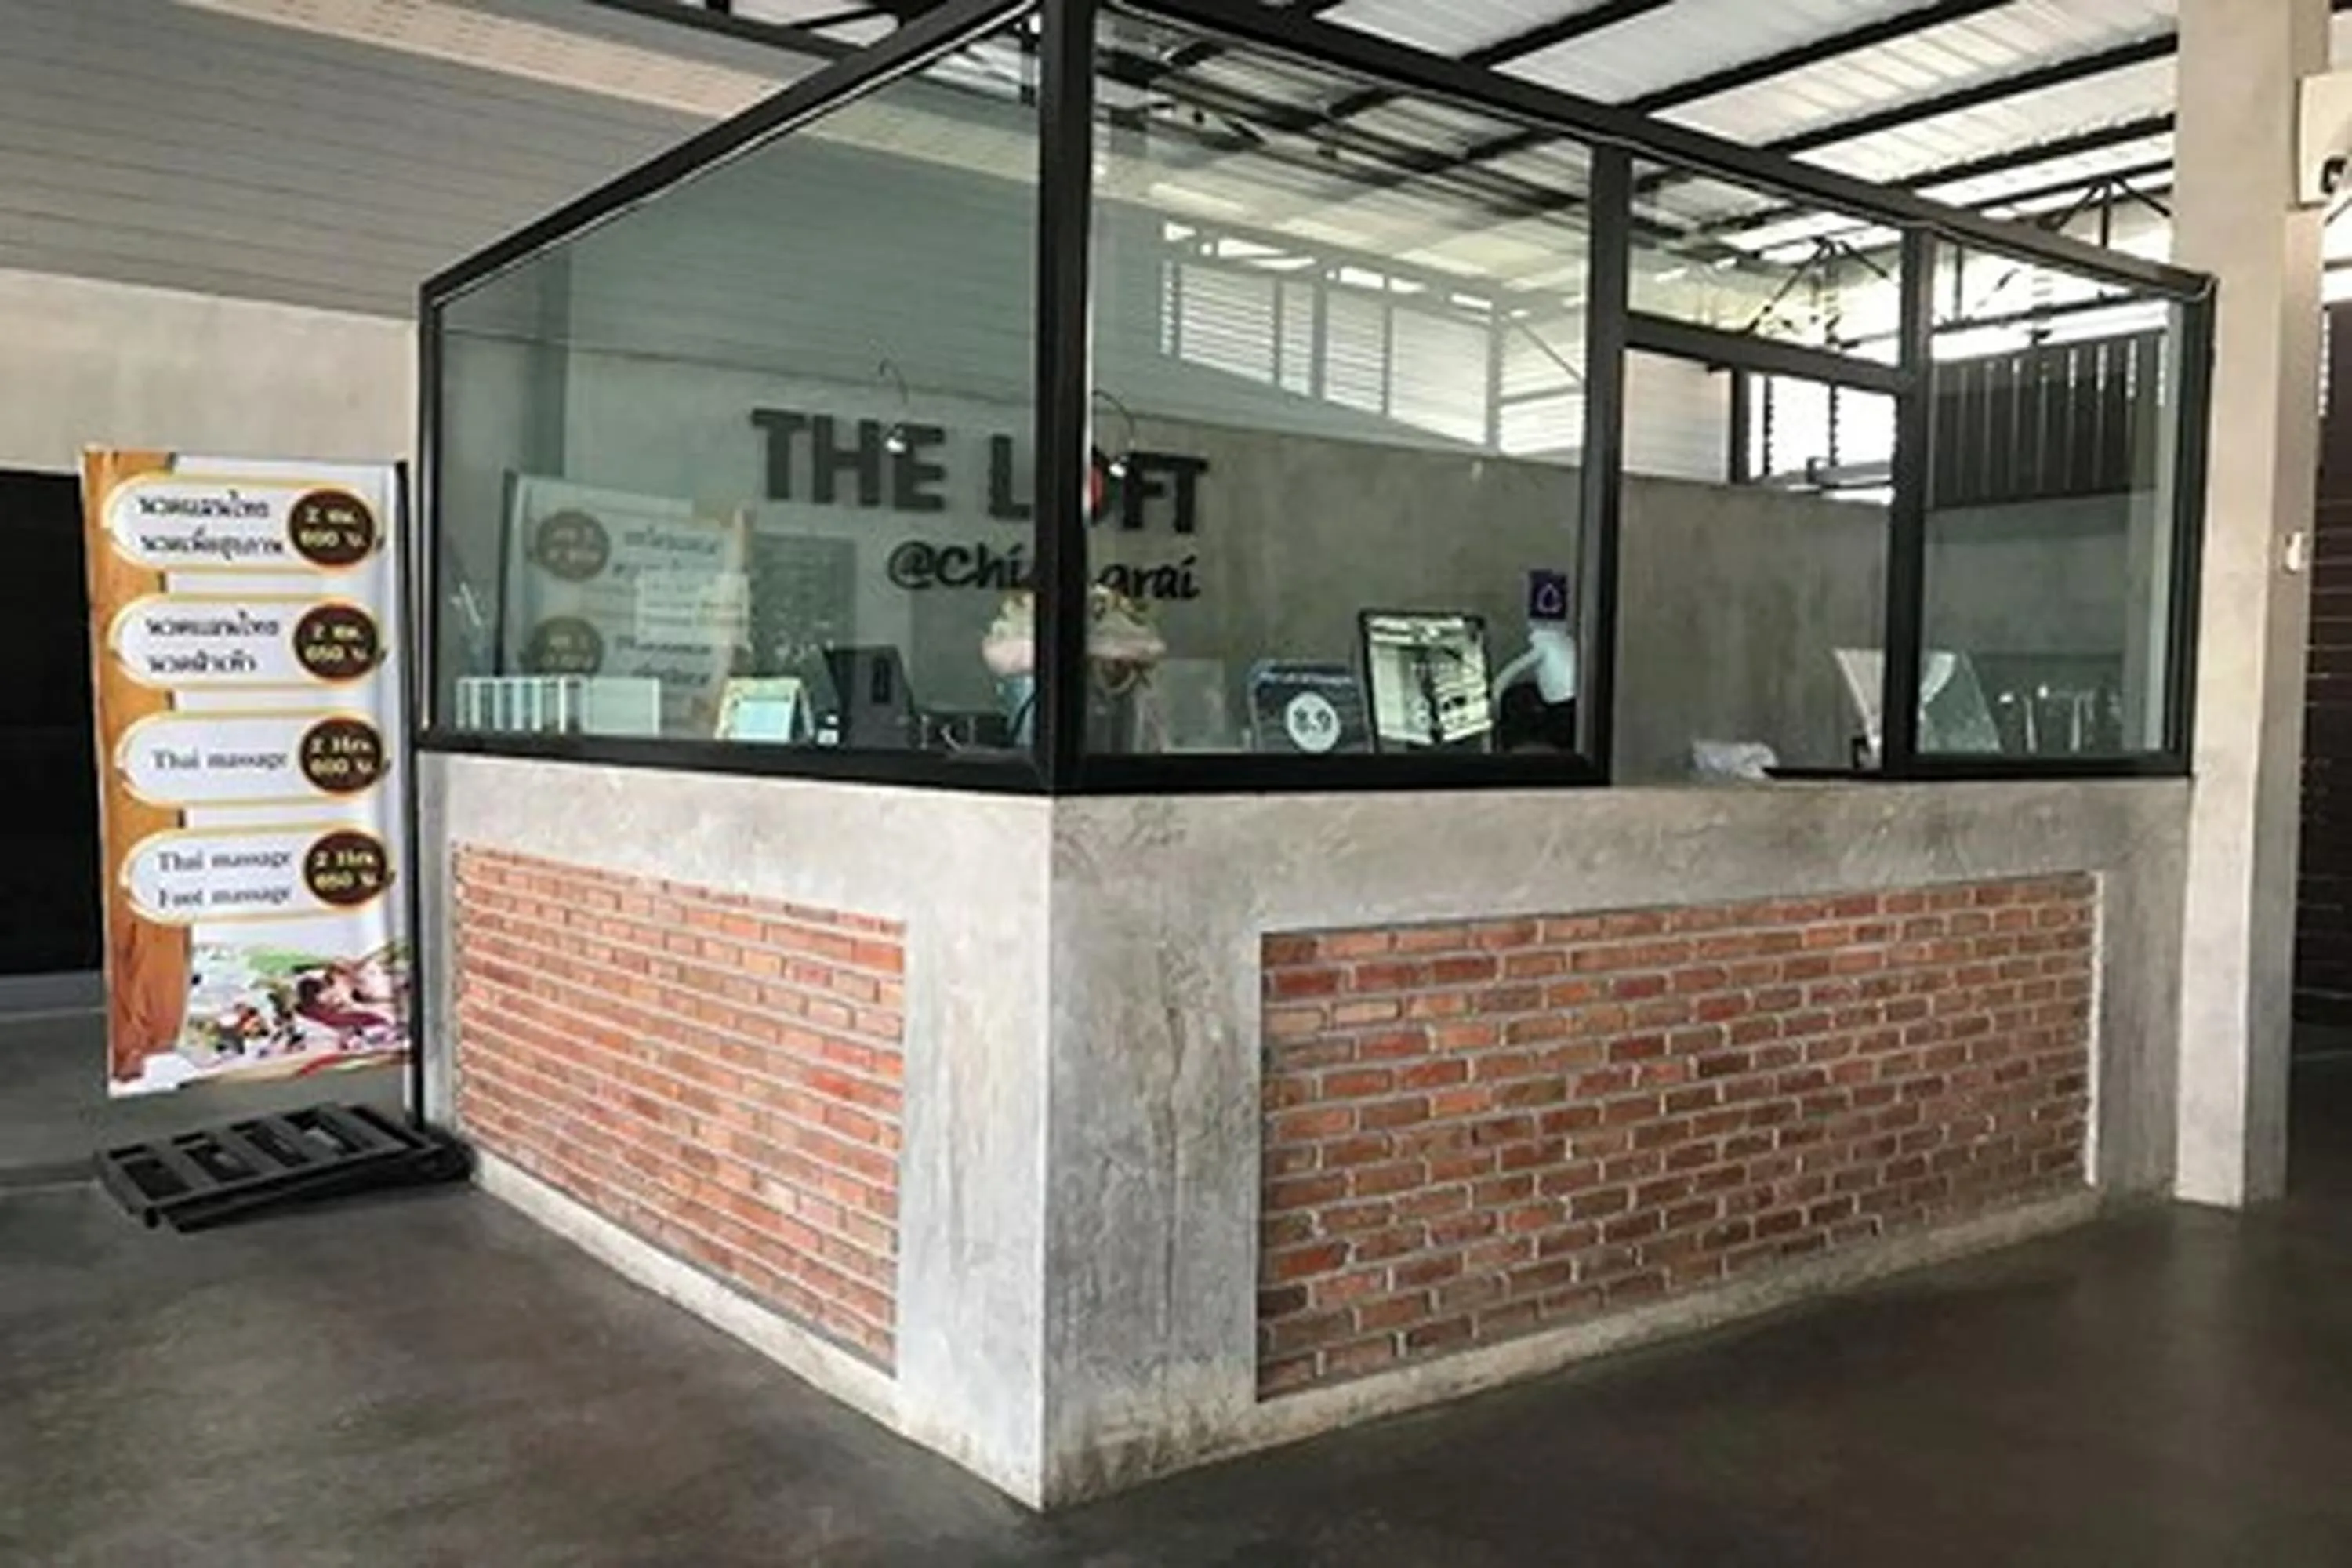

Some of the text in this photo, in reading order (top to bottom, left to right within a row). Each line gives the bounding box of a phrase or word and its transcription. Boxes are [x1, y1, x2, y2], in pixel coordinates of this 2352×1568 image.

[750, 407, 949, 512] THE
[153, 750, 288, 771] Thai massage
[159, 849, 292, 873] Thai massage
[158, 887, 291, 909] Foot massage
